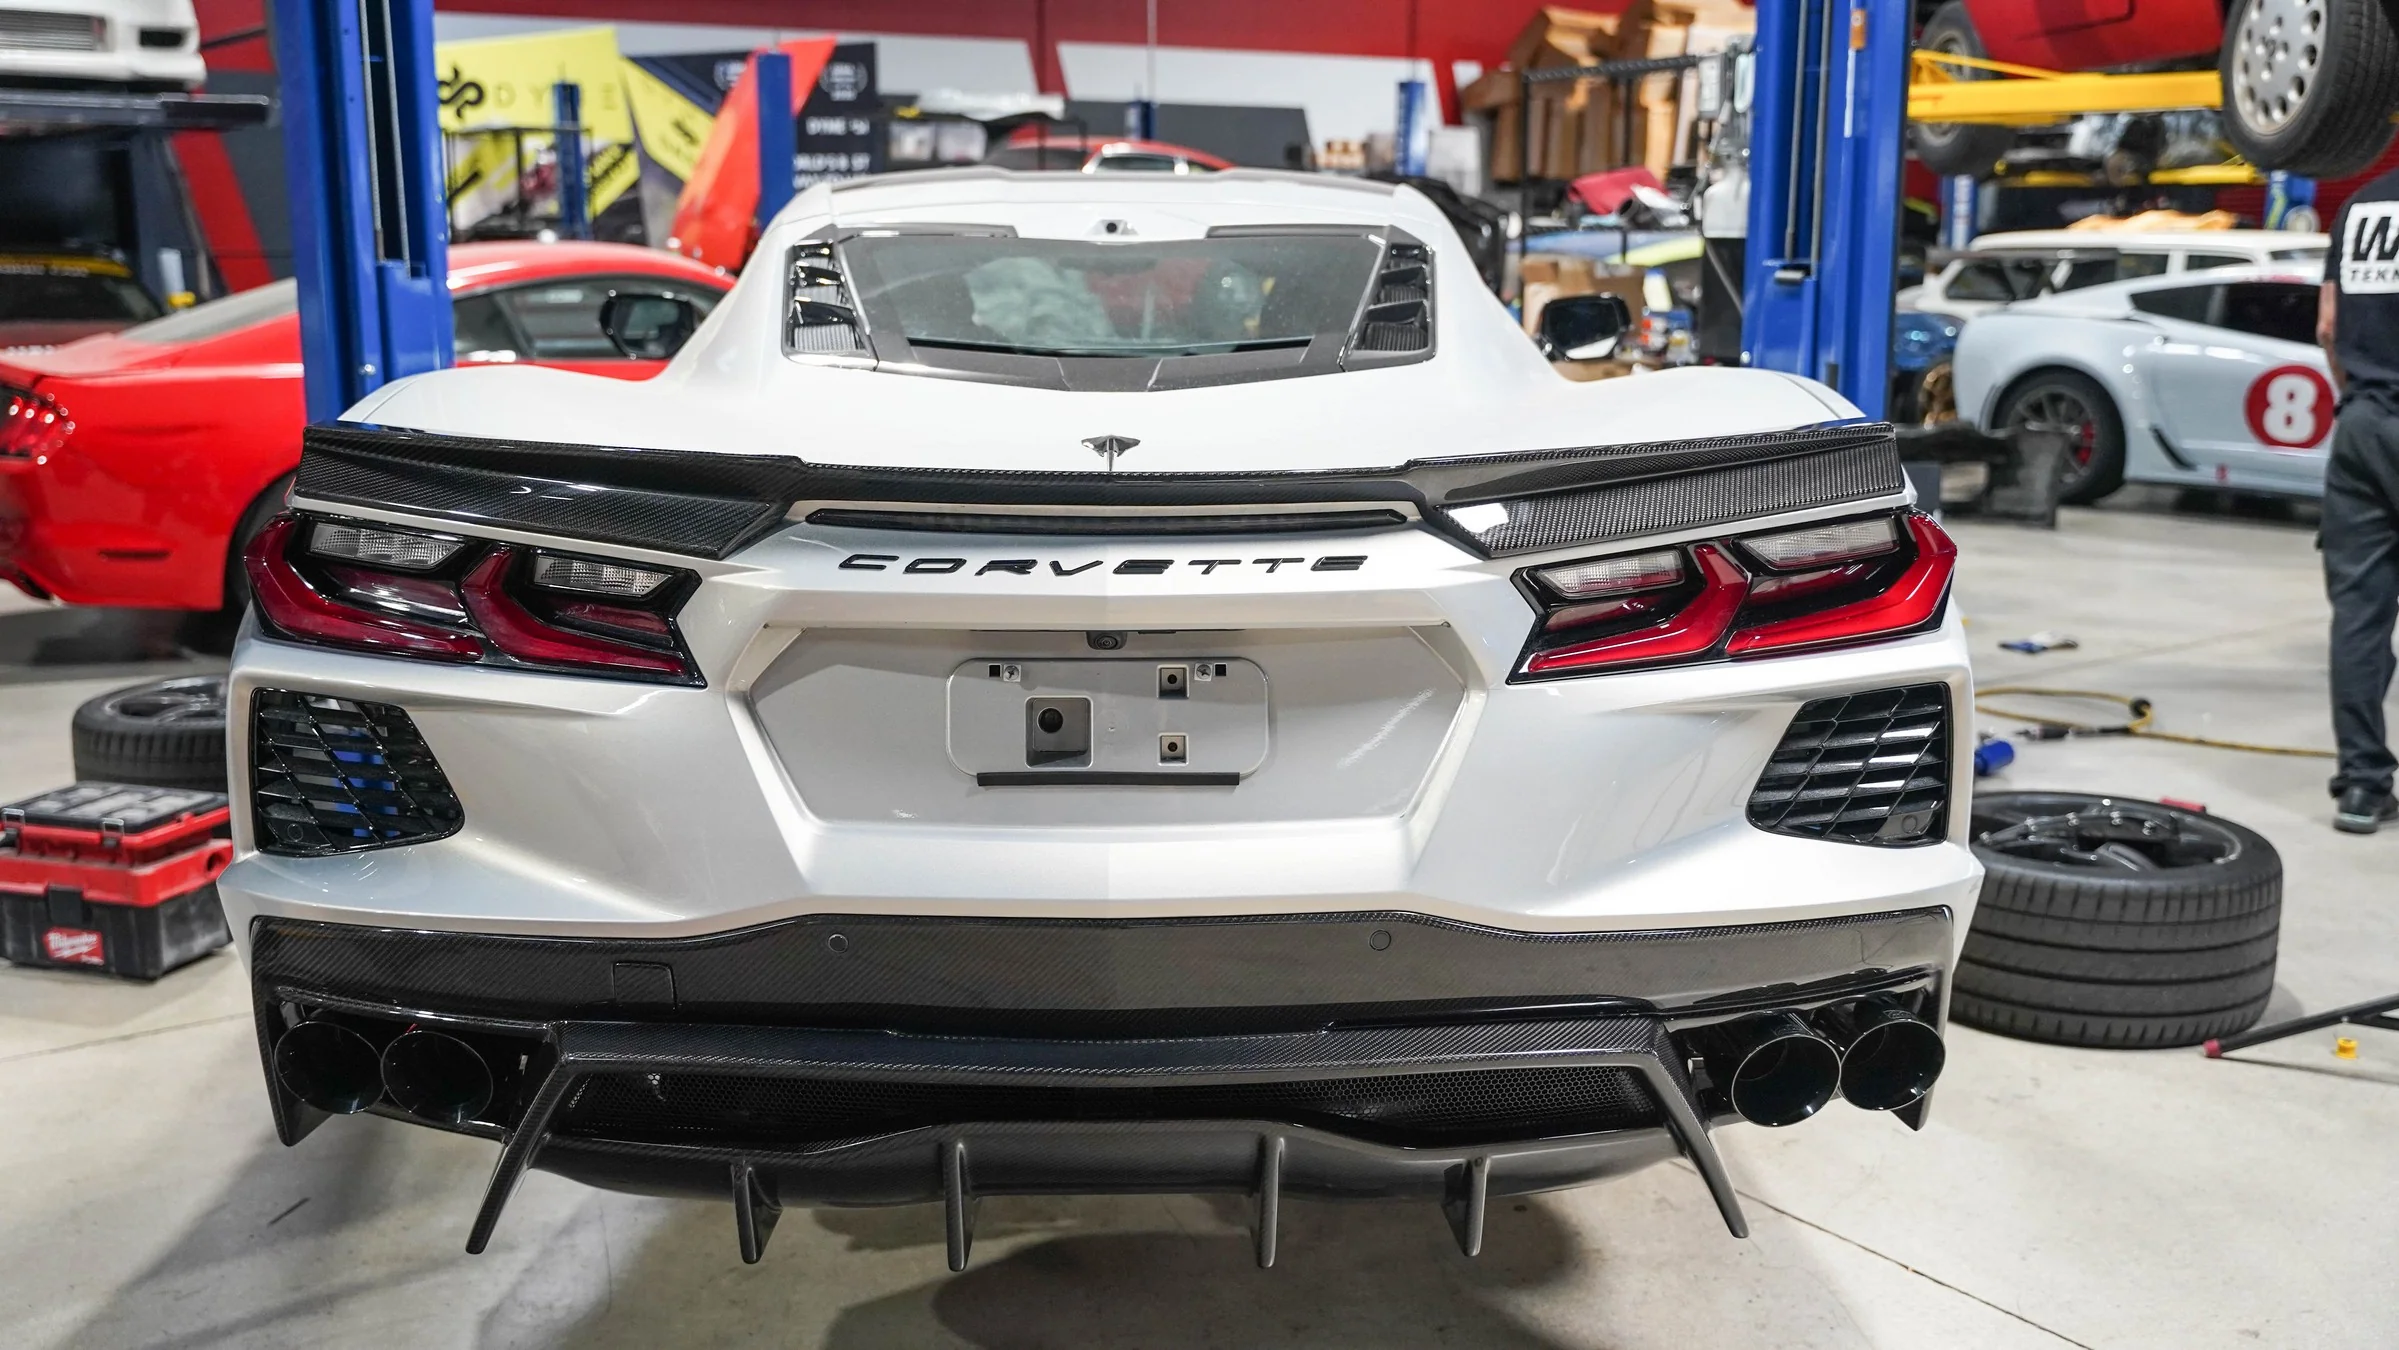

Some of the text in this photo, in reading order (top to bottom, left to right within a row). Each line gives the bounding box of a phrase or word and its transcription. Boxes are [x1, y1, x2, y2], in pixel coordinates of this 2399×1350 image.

[494, 82, 617, 112] DYE
[2262, 373, 2317, 444] 8
[838, 553, 1369, 577] CORVETTE
